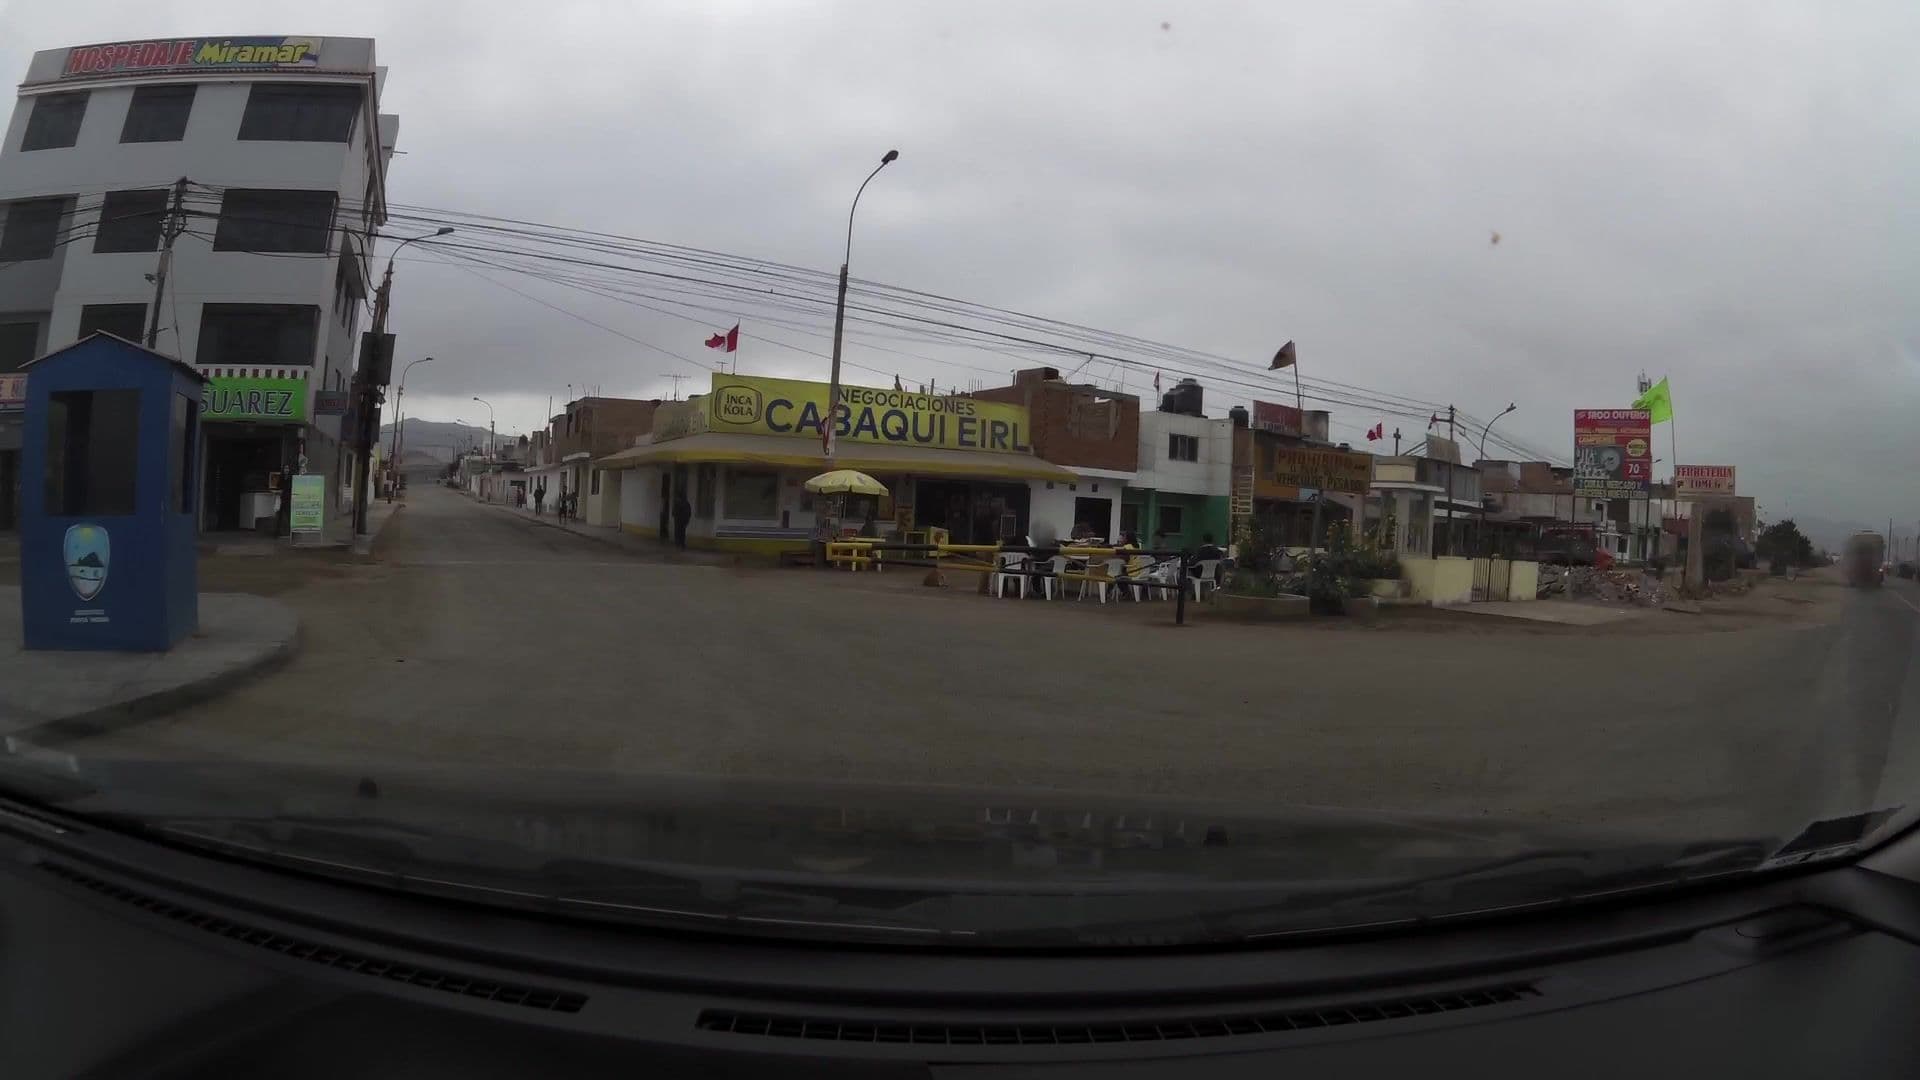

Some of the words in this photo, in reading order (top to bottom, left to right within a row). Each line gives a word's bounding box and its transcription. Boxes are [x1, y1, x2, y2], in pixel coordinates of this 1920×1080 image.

[67, 41, 194, 74] HOSPEDAJE
[196, 41, 309, 64] Miramar
[199, 389, 294, 416] SUAREZ
[726, 392, 752, 407] INCA
[838, 387, 975, 416] NEGOCIACIONES
[723, 404, 753, 418] KOLA
[765, 398, 945, 444] CABAQUI
[958, 416, 1033, 451] EIRL
[1628, 463, 1640, 474] 70
[1676, 466, 1732, 478] FERRETERIA
